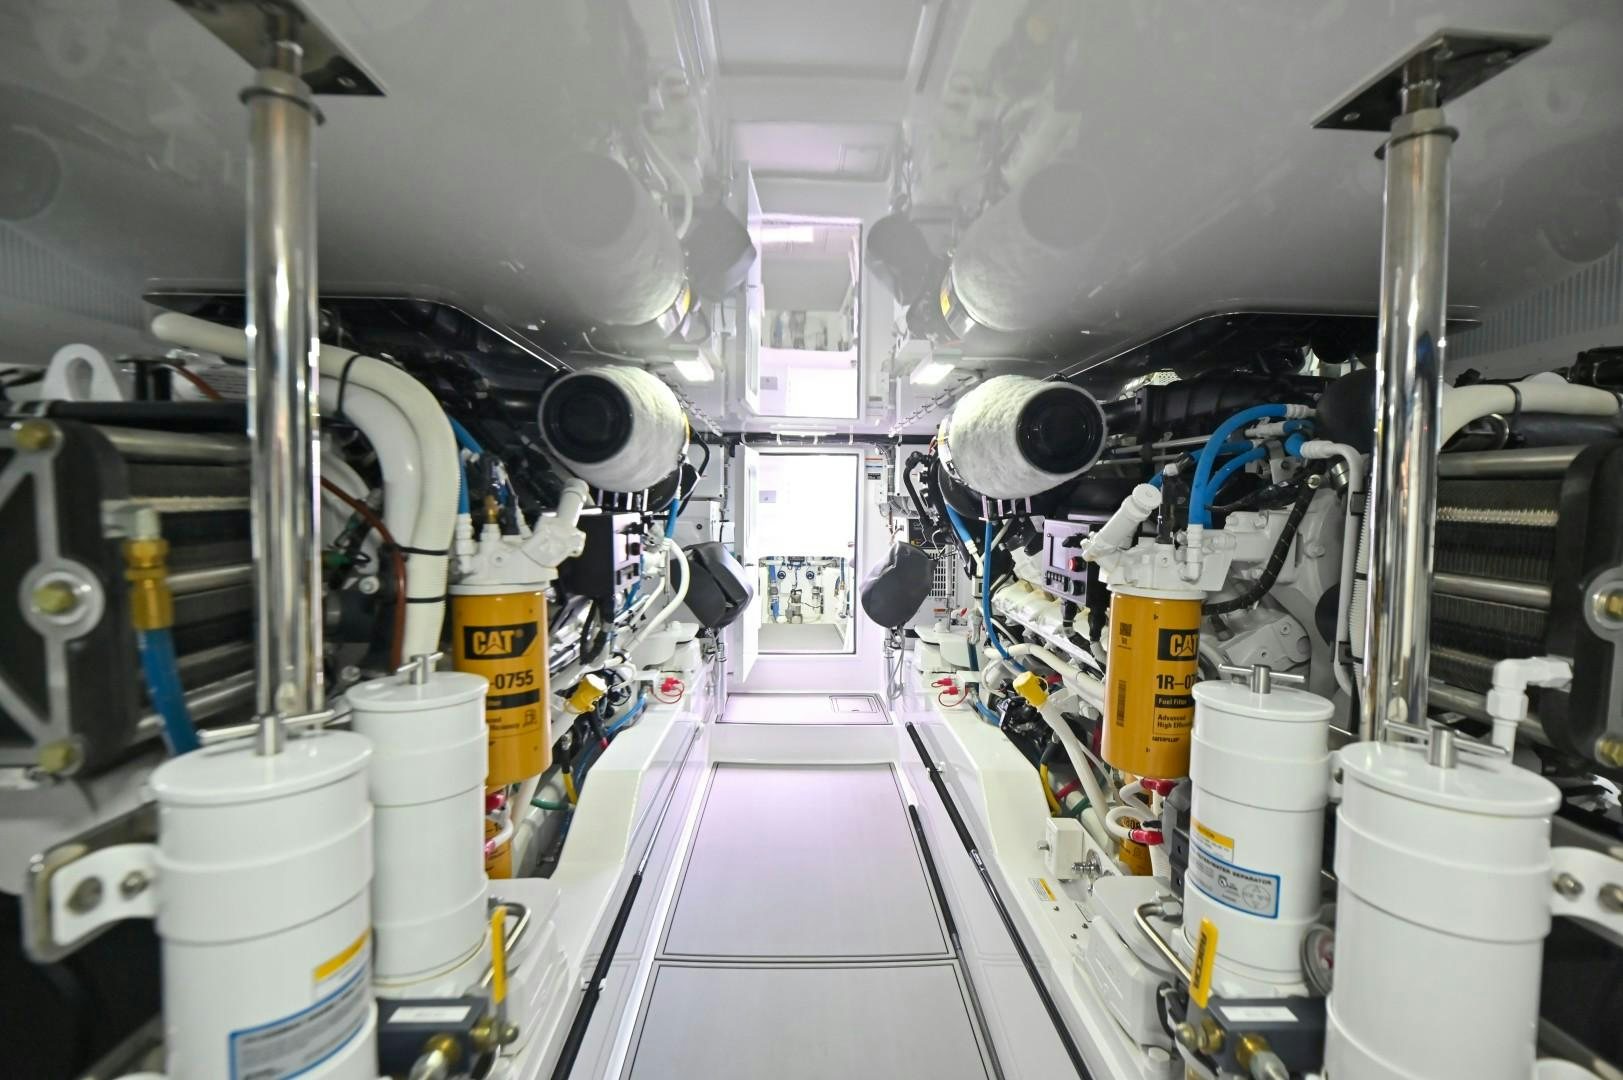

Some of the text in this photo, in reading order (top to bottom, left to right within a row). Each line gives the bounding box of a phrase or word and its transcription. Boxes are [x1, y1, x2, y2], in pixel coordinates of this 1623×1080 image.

[473, 631, 515, 656] CAT
[1169, 633, 1199, 657] CAT
[1158, 697, 1172, 705] Fuel
[1157, 721, 1172, 729] High
